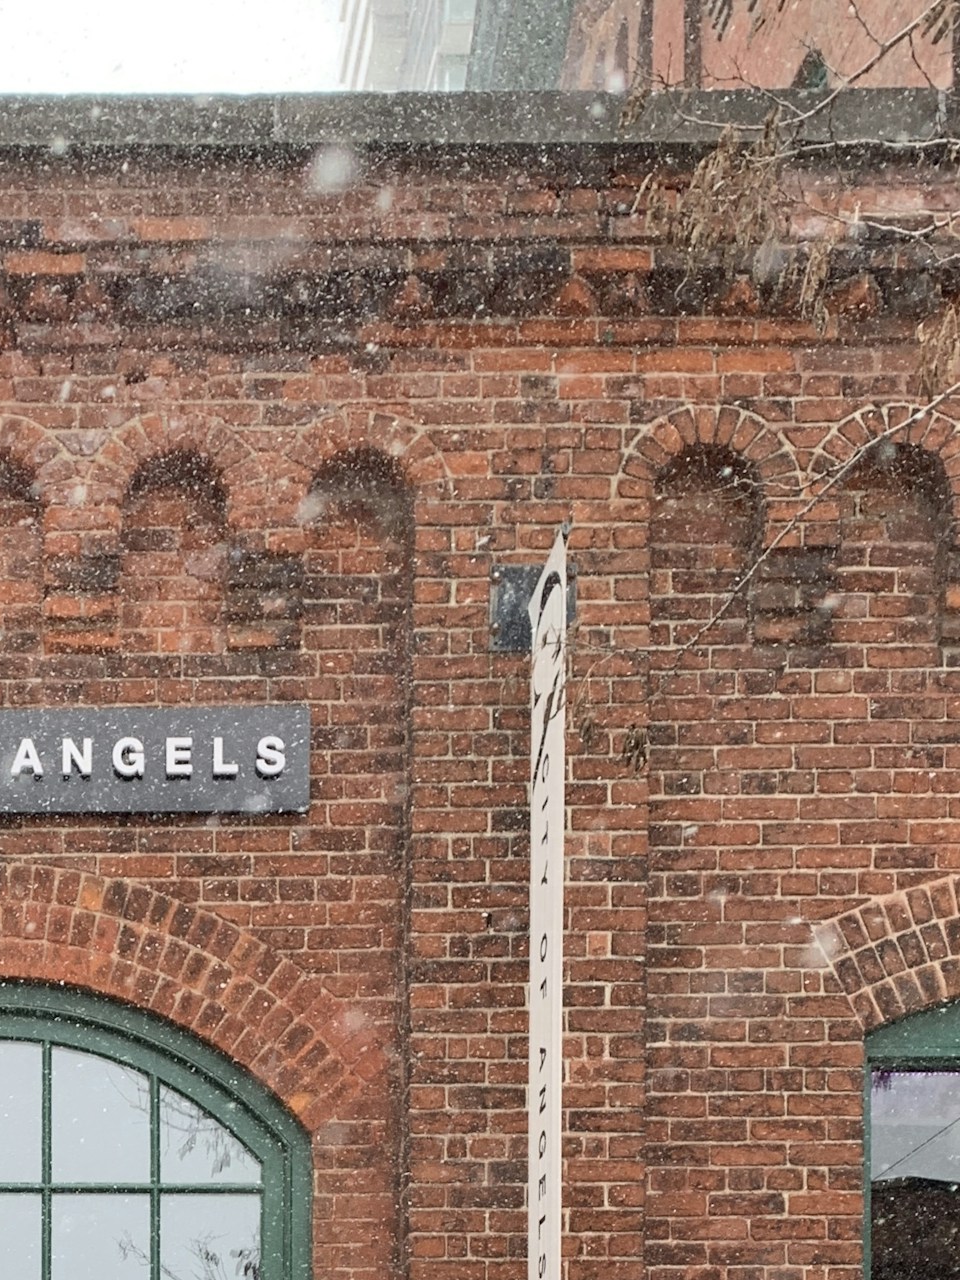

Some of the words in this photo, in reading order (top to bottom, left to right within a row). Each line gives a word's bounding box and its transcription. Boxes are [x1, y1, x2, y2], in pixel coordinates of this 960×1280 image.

[11, 734, 287, 779] ANGELS
[538, 932, 548, 1000] OF
[537, 1047, 548, 1279] ANGELS
